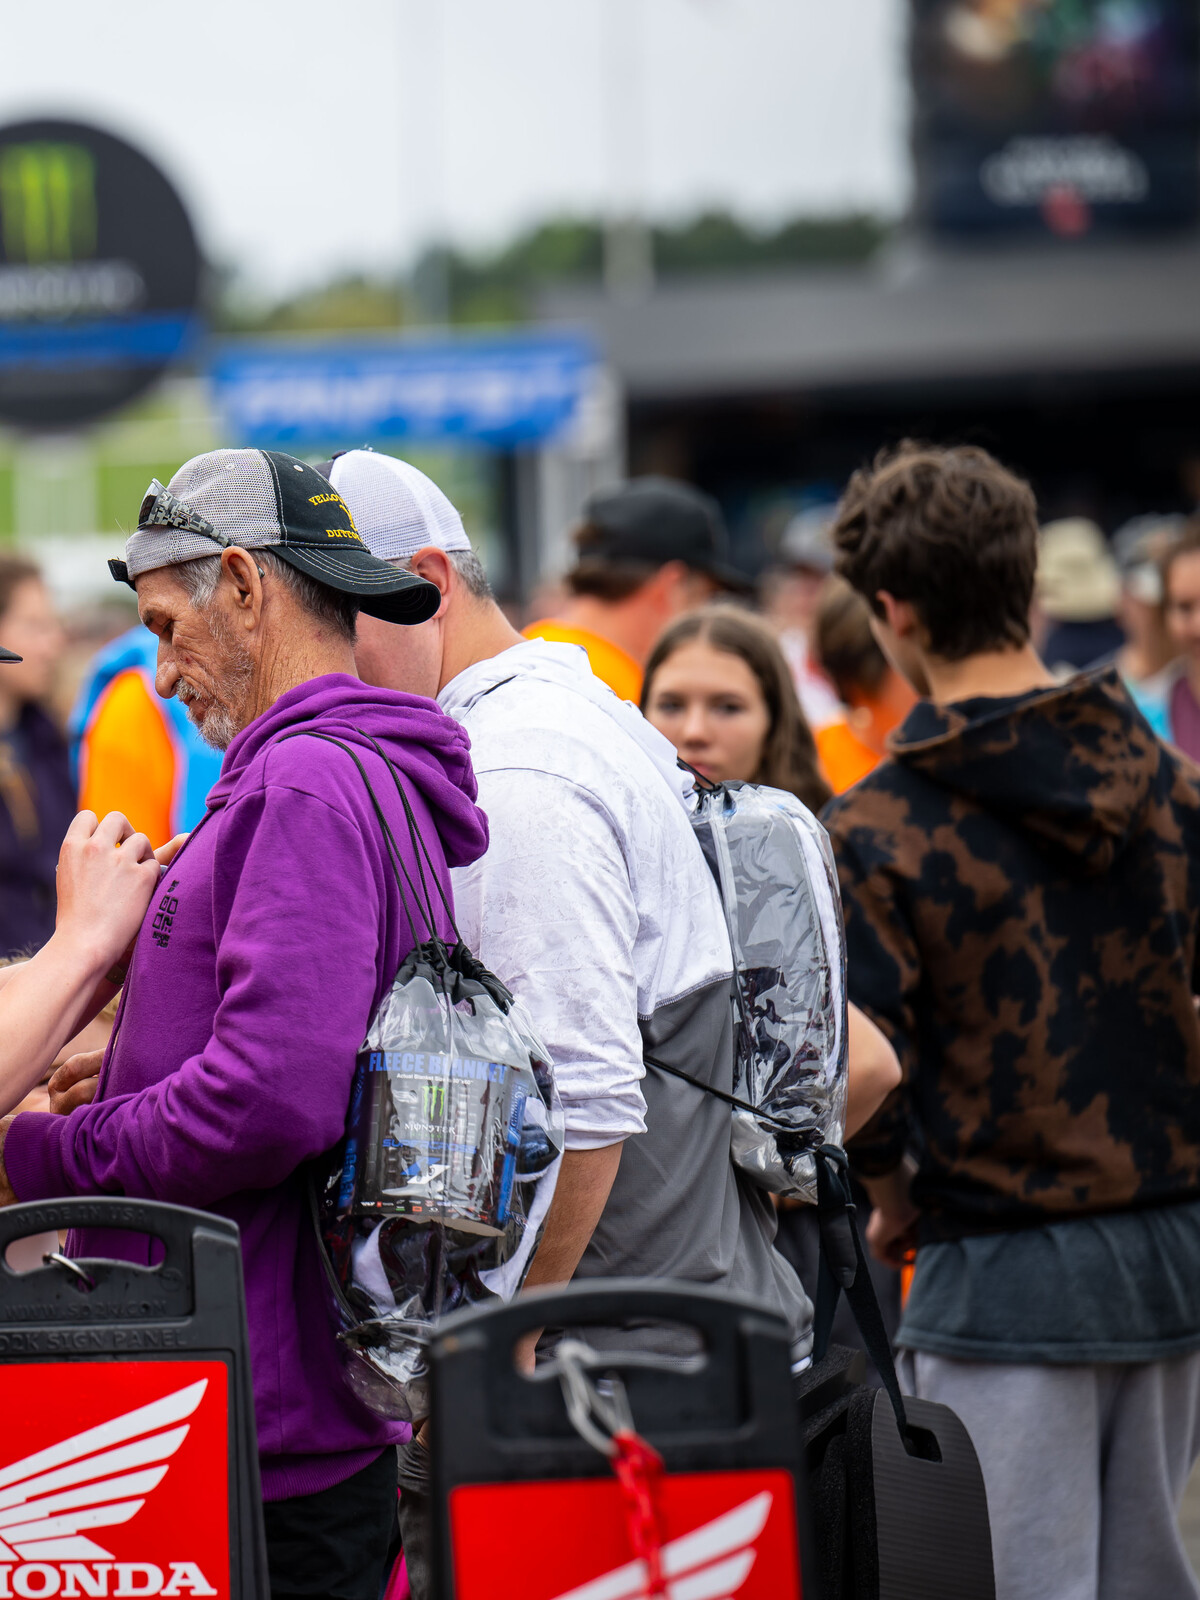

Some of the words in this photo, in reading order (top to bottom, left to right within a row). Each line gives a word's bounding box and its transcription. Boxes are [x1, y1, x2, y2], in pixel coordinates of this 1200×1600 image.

[308, 493, 344, 506] YELLO
[369, 1052, 425, 1072] FLEECE
[428, 1055, 507, 1084] BLANKET
[404, 1123, 456, 1135] MONSTER
[16, 1207, 72, 1226] MADE
[78, 1206, 101, 1221] IN
[109, 1206, 148, 1224] USA
[47, 1331, 105, 1351] SIGN
[113, 1329, 188, 1348] PANEL
